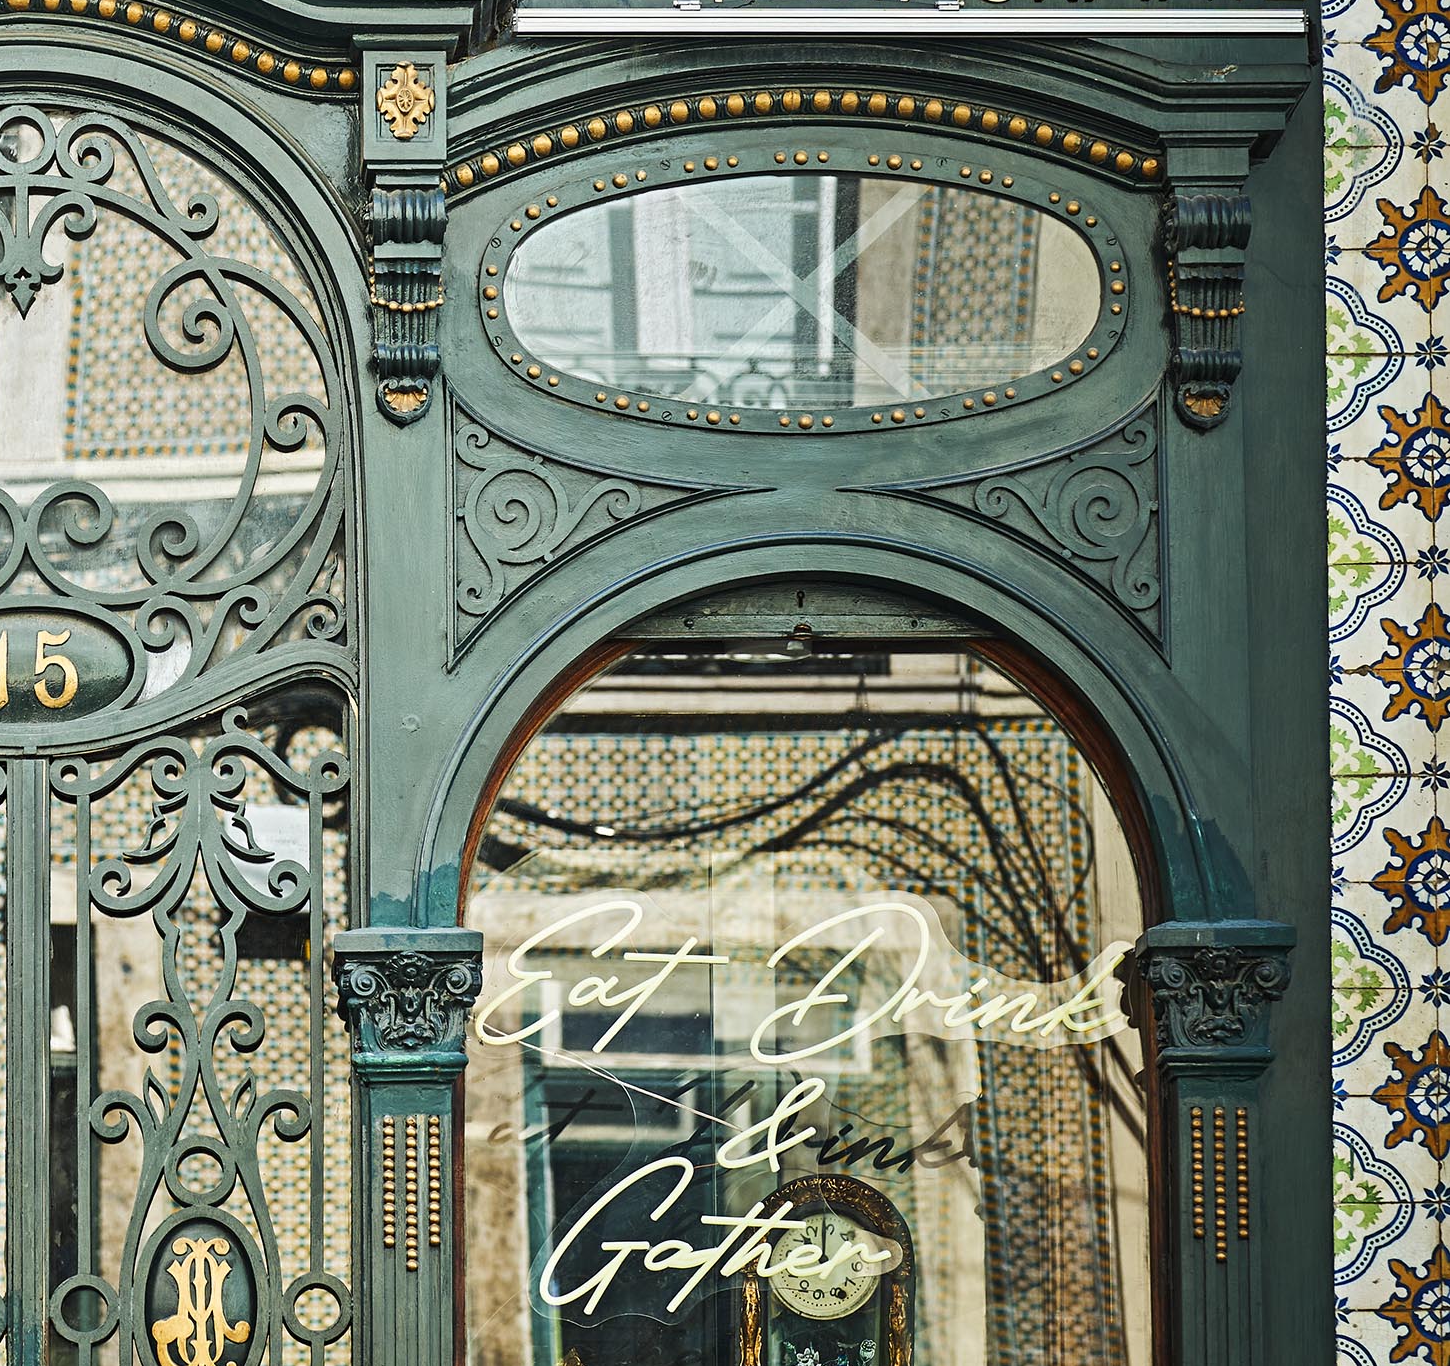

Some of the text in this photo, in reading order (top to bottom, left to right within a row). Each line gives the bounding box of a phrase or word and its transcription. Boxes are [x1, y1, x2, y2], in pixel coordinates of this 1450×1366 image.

[475, 900, 1129, 1064] Eat Drink
[716, 1077, 826, 1173] &
[539, 1155, 891, 1316] Gather
